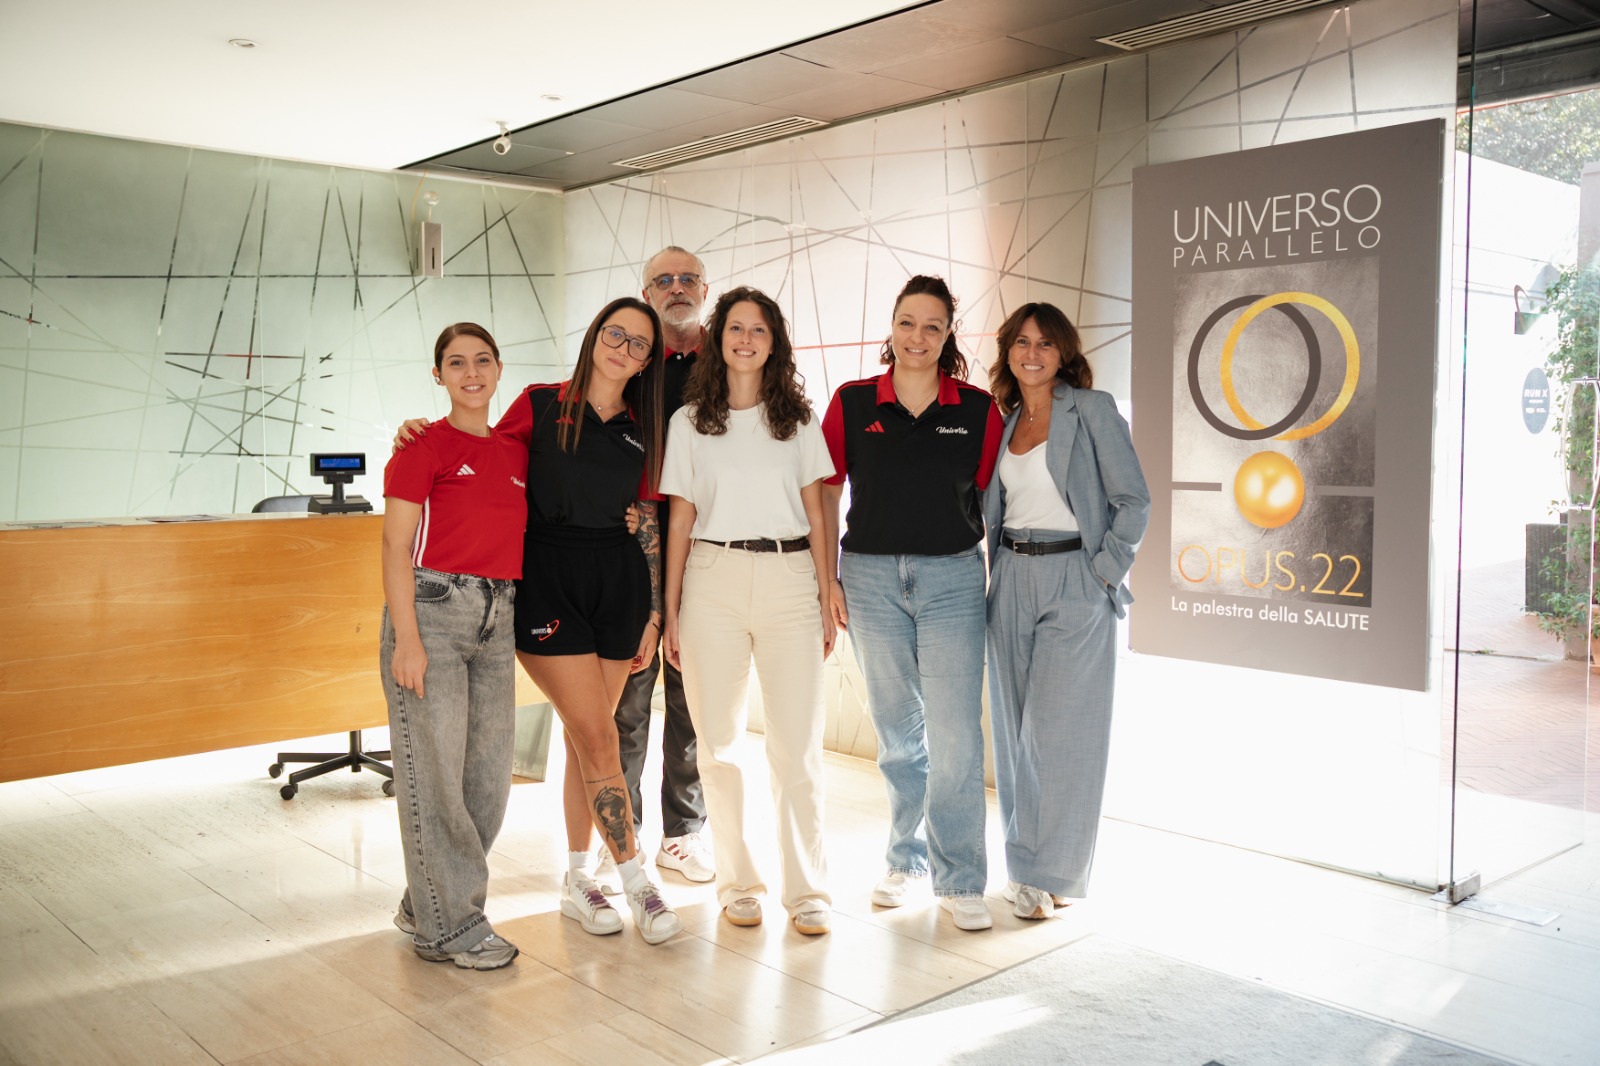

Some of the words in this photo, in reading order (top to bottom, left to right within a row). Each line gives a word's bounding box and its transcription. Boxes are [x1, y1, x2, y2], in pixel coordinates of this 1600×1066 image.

[1173, 184, 1382, 244] UNIVERSO
[1173, 225, 1381, 268] PARALLELO
[1177, 544, 1365, 598] OPUS.22
[1171, 596, 1188, 612] La
[1192, 599, 1254, 619] palestra
[1258, 605, 1299, 624] della
[1303, 609, 1370, 631] SALUTE
